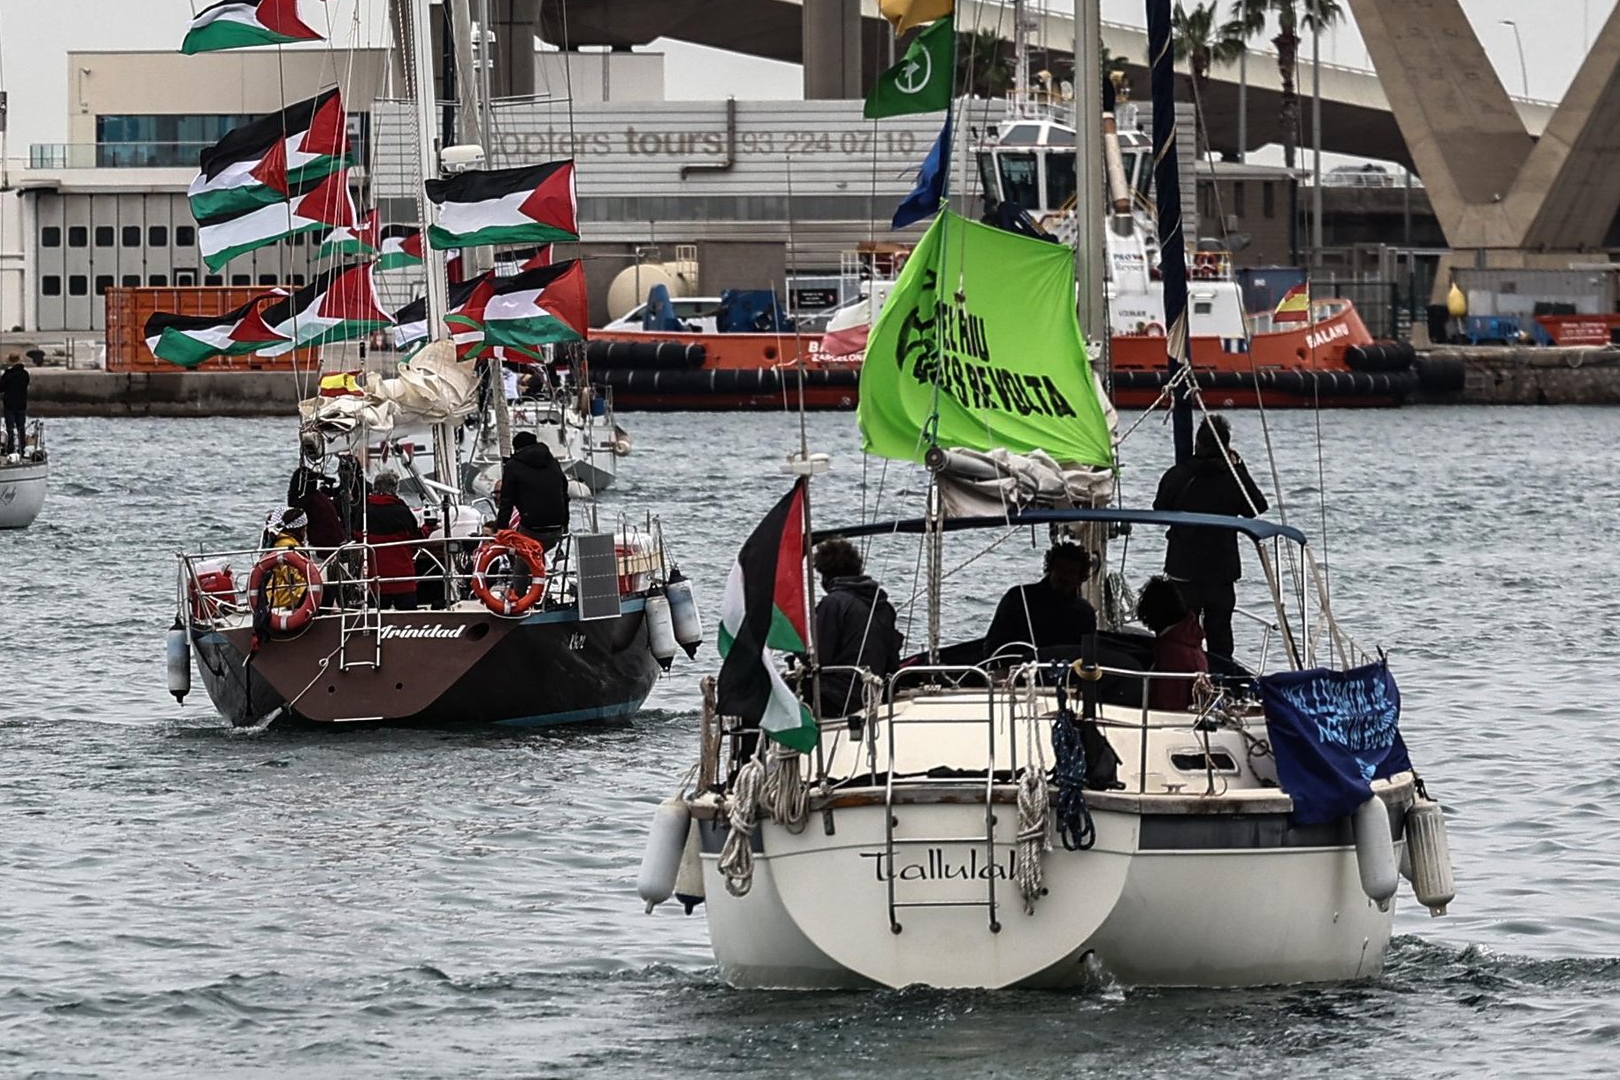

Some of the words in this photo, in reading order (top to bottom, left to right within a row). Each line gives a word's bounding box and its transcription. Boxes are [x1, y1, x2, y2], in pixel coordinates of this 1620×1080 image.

[624, 125, 722, 157] tours
[742, 130, 774, 155] 93
[784, 130, 830, 155] 224
[840, 129, 872, 155] 07
[884, 129, 916, 155] 10
[964, 362, 1078, 419] REVOLTA
[379, 623, 467, 640] Trinidad
